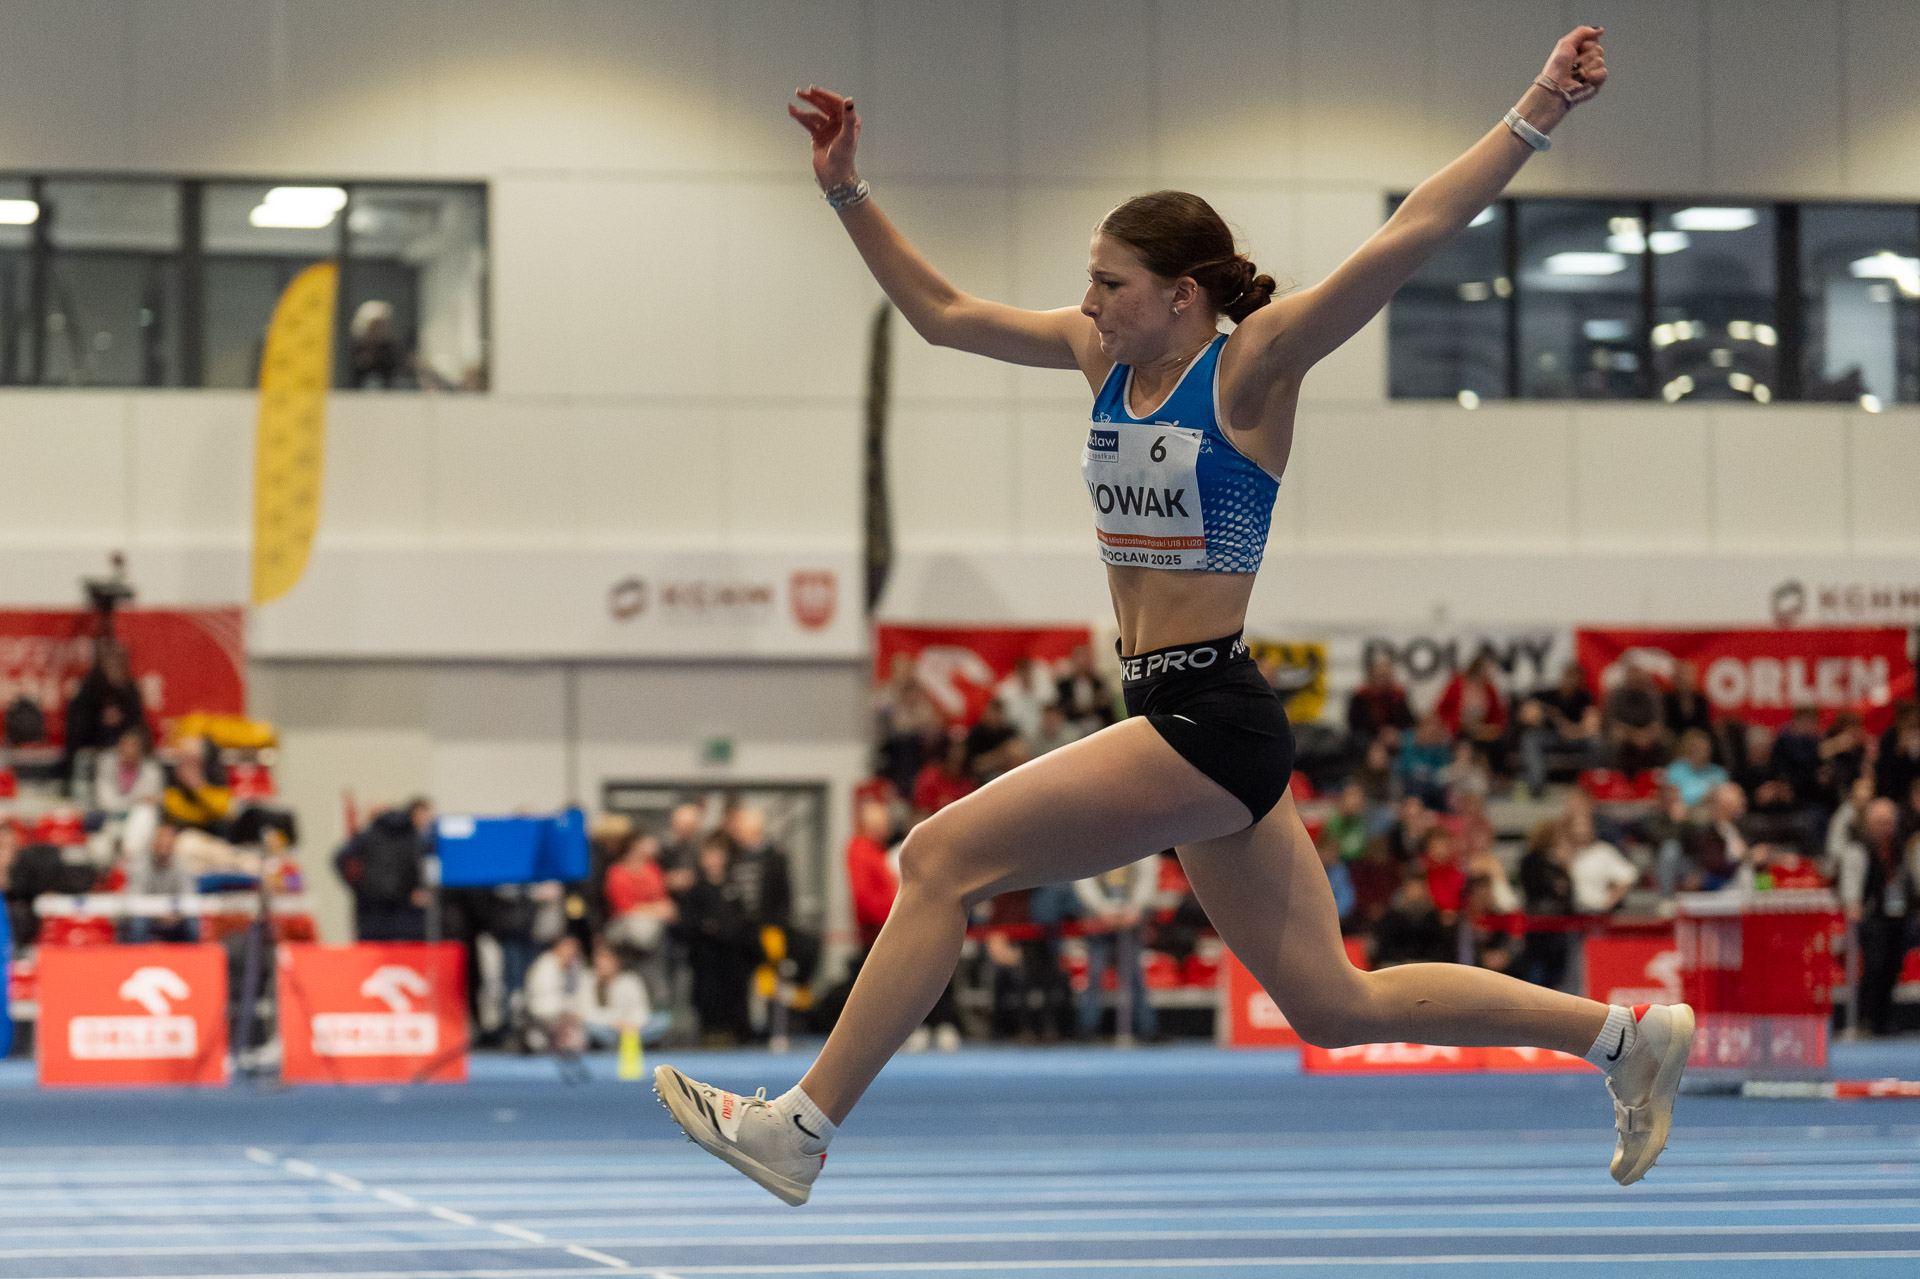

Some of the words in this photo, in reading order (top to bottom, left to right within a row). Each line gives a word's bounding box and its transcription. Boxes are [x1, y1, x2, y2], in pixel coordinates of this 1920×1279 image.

[1150, 436, 1167, 462] 6
[1109, 537, 1147, 546] Mistrzostwa
[1151, 554, 1182, 565] 2025
[1146, 647, 1218, 677] PRO
[1706, 655, 1890, 709] ORLEN
